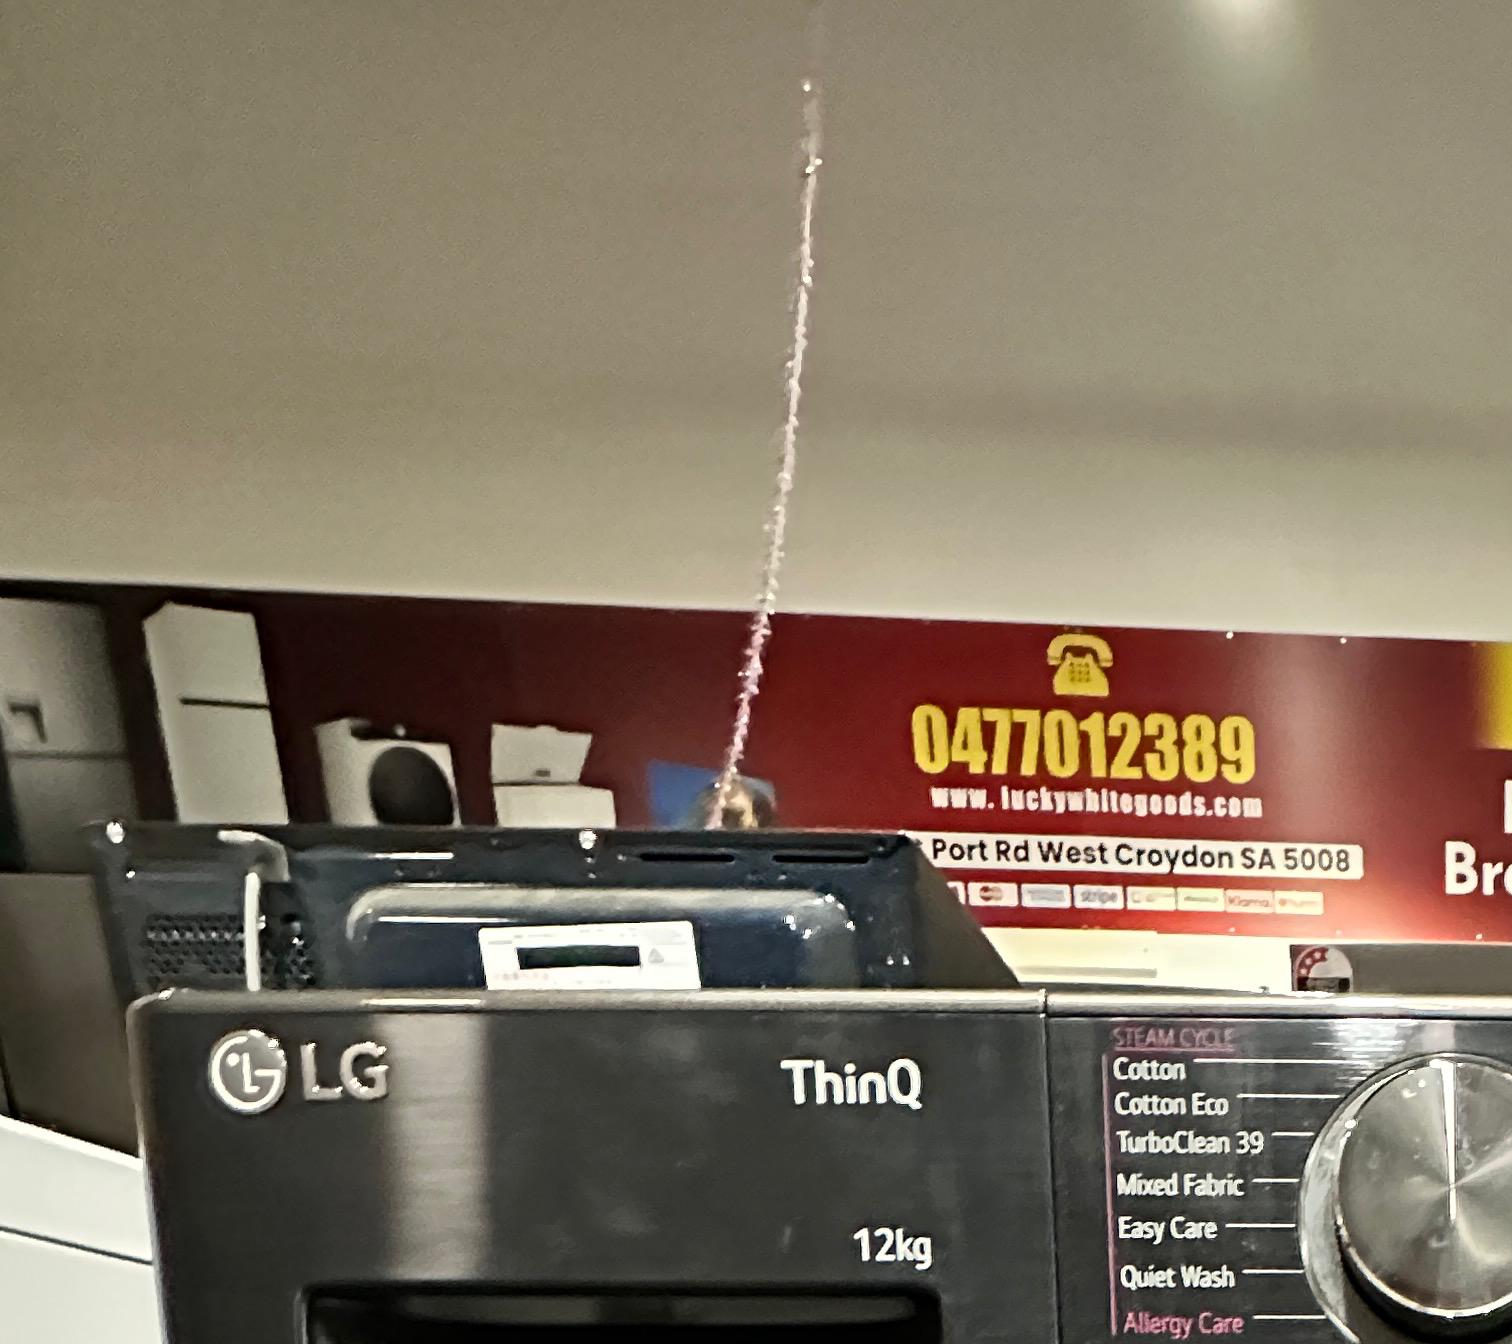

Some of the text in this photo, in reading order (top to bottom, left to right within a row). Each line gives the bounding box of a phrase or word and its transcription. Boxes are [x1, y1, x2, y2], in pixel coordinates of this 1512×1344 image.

[911, 704, 1256, 785] 0477012389
[932, 838, 1350, 875] Port Rd West Croydon SA 5008
[1112, 1028, 1175, 1048] STEAM
[301, 1040, 390, 1101] LG
[1113, 1057, 1186, 1081] Cotton
[781, 1056, 923, 1111] ThinQ
[1114, 1093, 1229, 1116] Cotton Eco
[1116, 1130, 1264, 1155] TurboClean 39
[1116, 1173, 1245, 1197] Mixed Fabric
[1118, 1217, 1218, 1244] Easy Care
[854, 1227, 933, 1270] 12kg
[1120, 1265, 1236, 1291] Quiet Wash
[1123, 1312, 1245, 1340] Allergy Care
